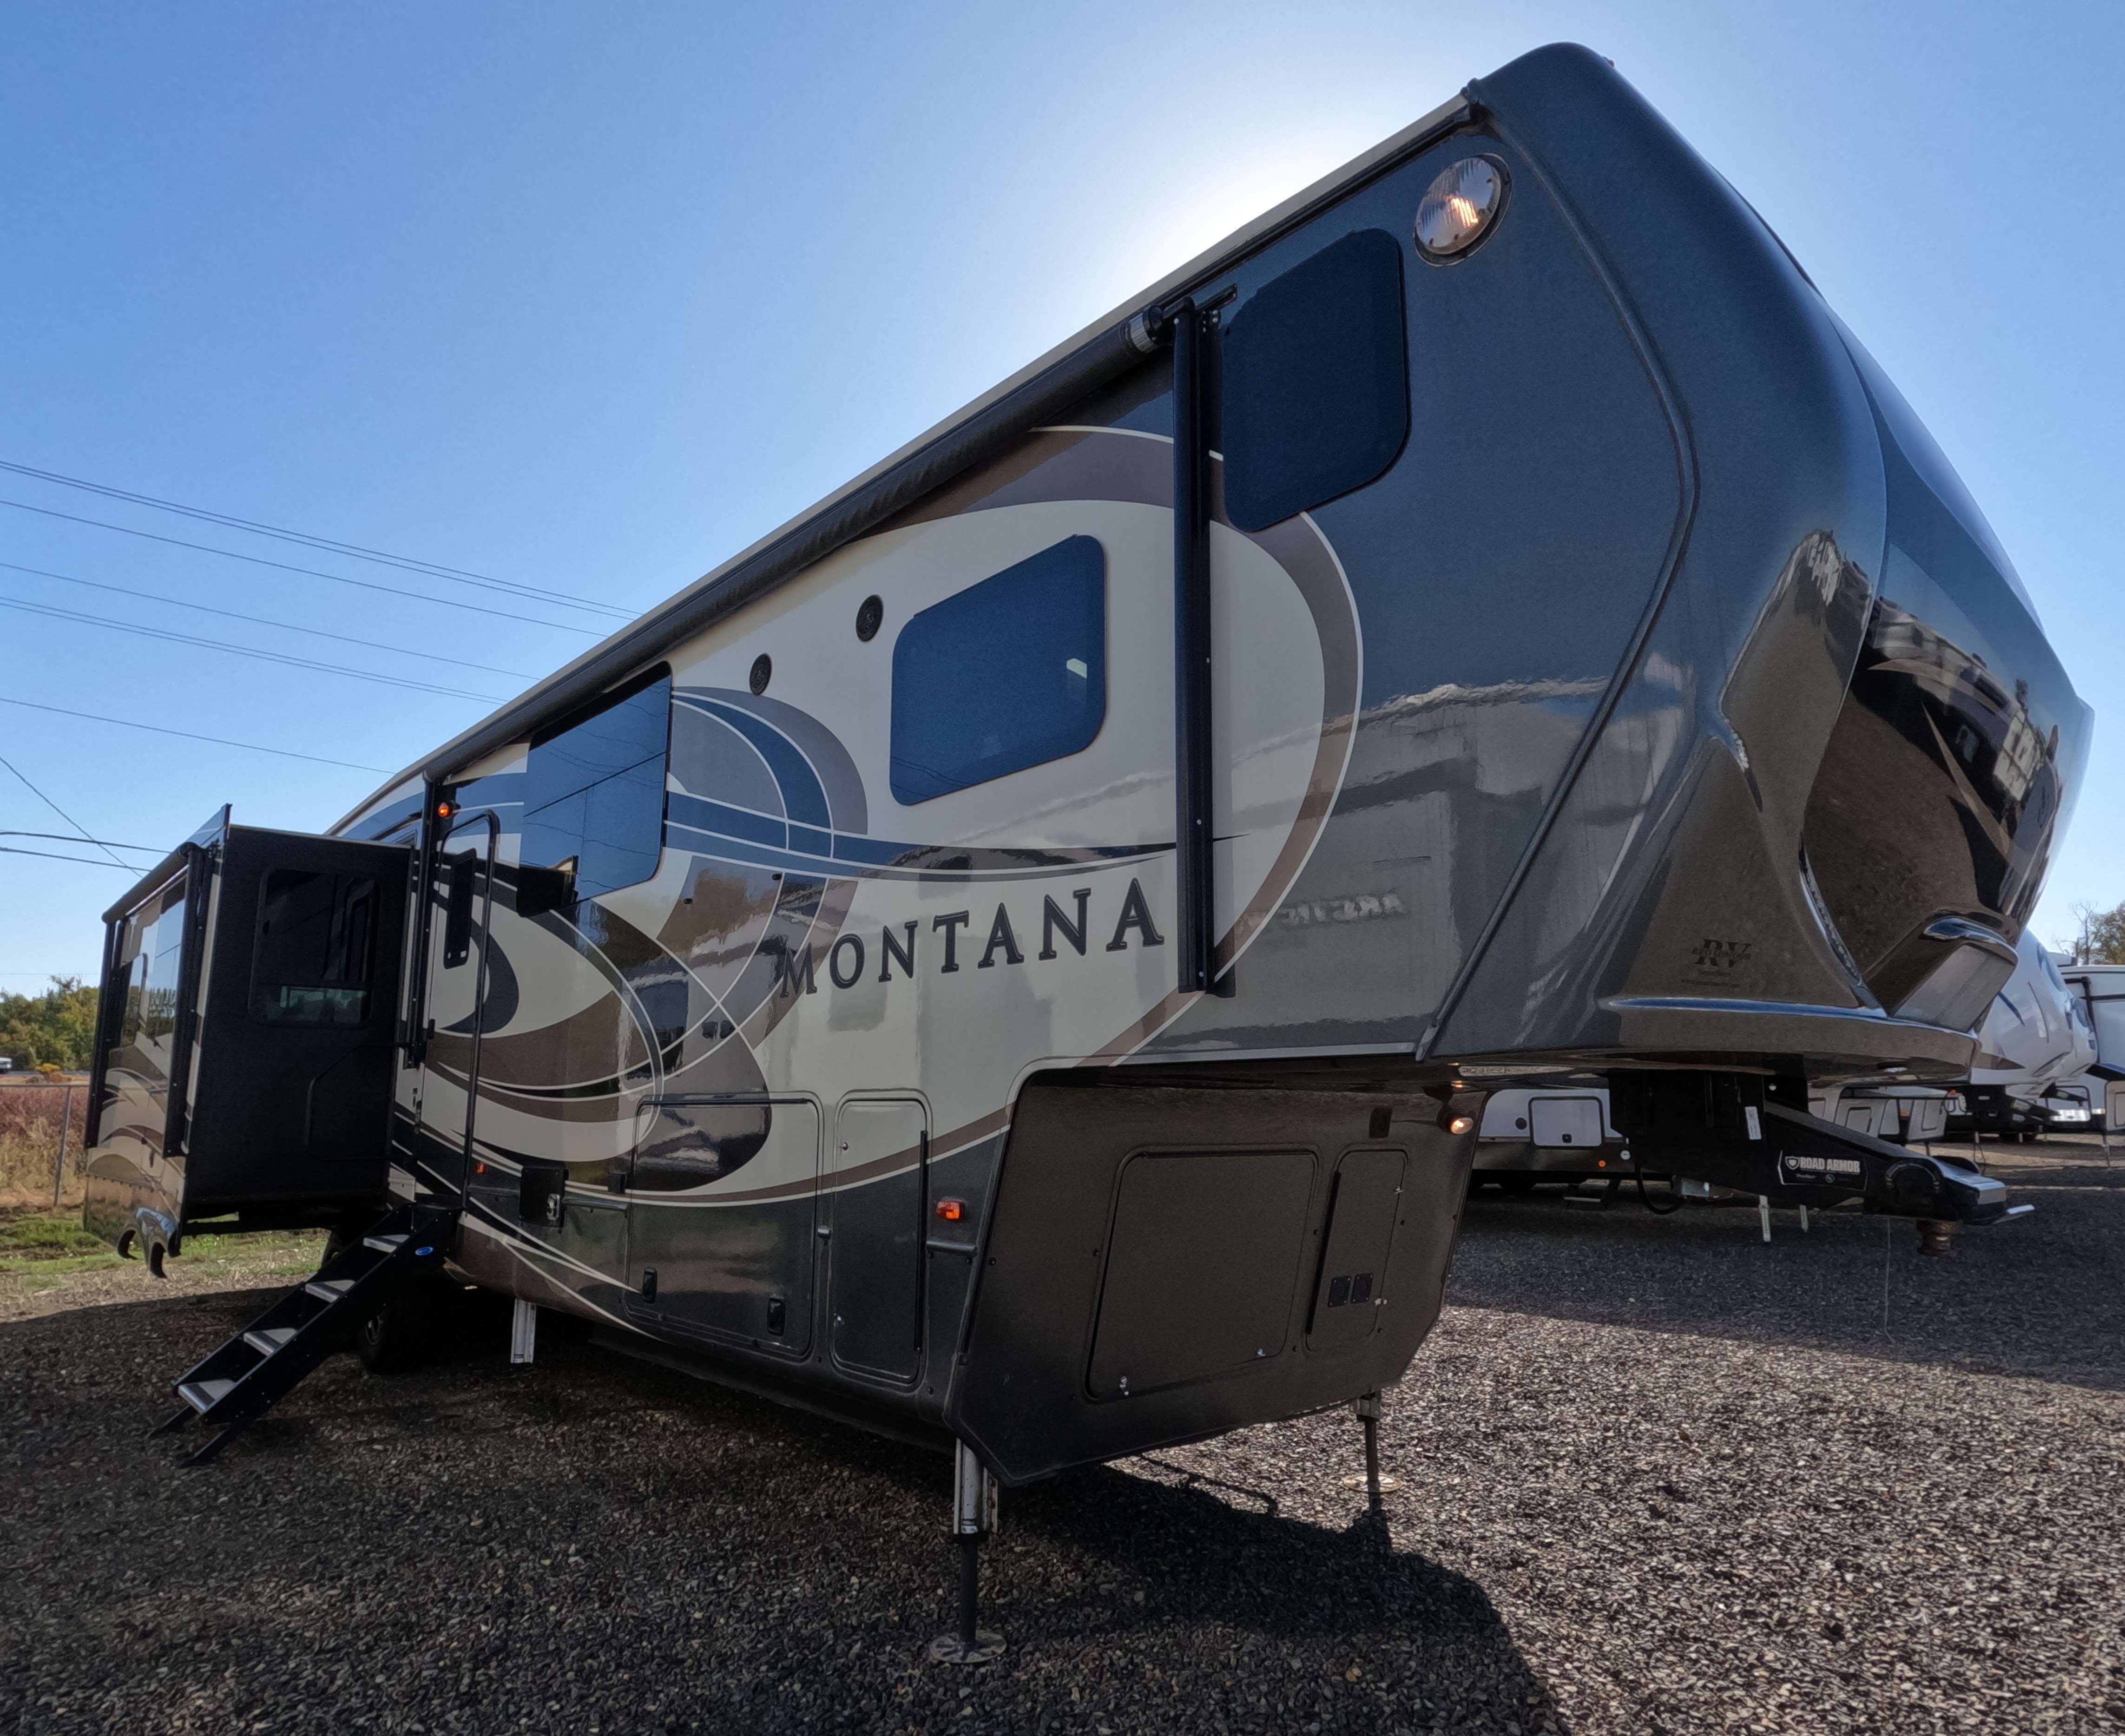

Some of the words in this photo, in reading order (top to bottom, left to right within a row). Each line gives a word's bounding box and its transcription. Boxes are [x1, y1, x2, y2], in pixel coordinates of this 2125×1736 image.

[779, 877, 1165, 998] MONTANA
[1693, 939, 1752, 968] RV
[1800, 1157, 1825, 1170] ROAD
[1826, 1158, 1860, 1173] ARMOR
